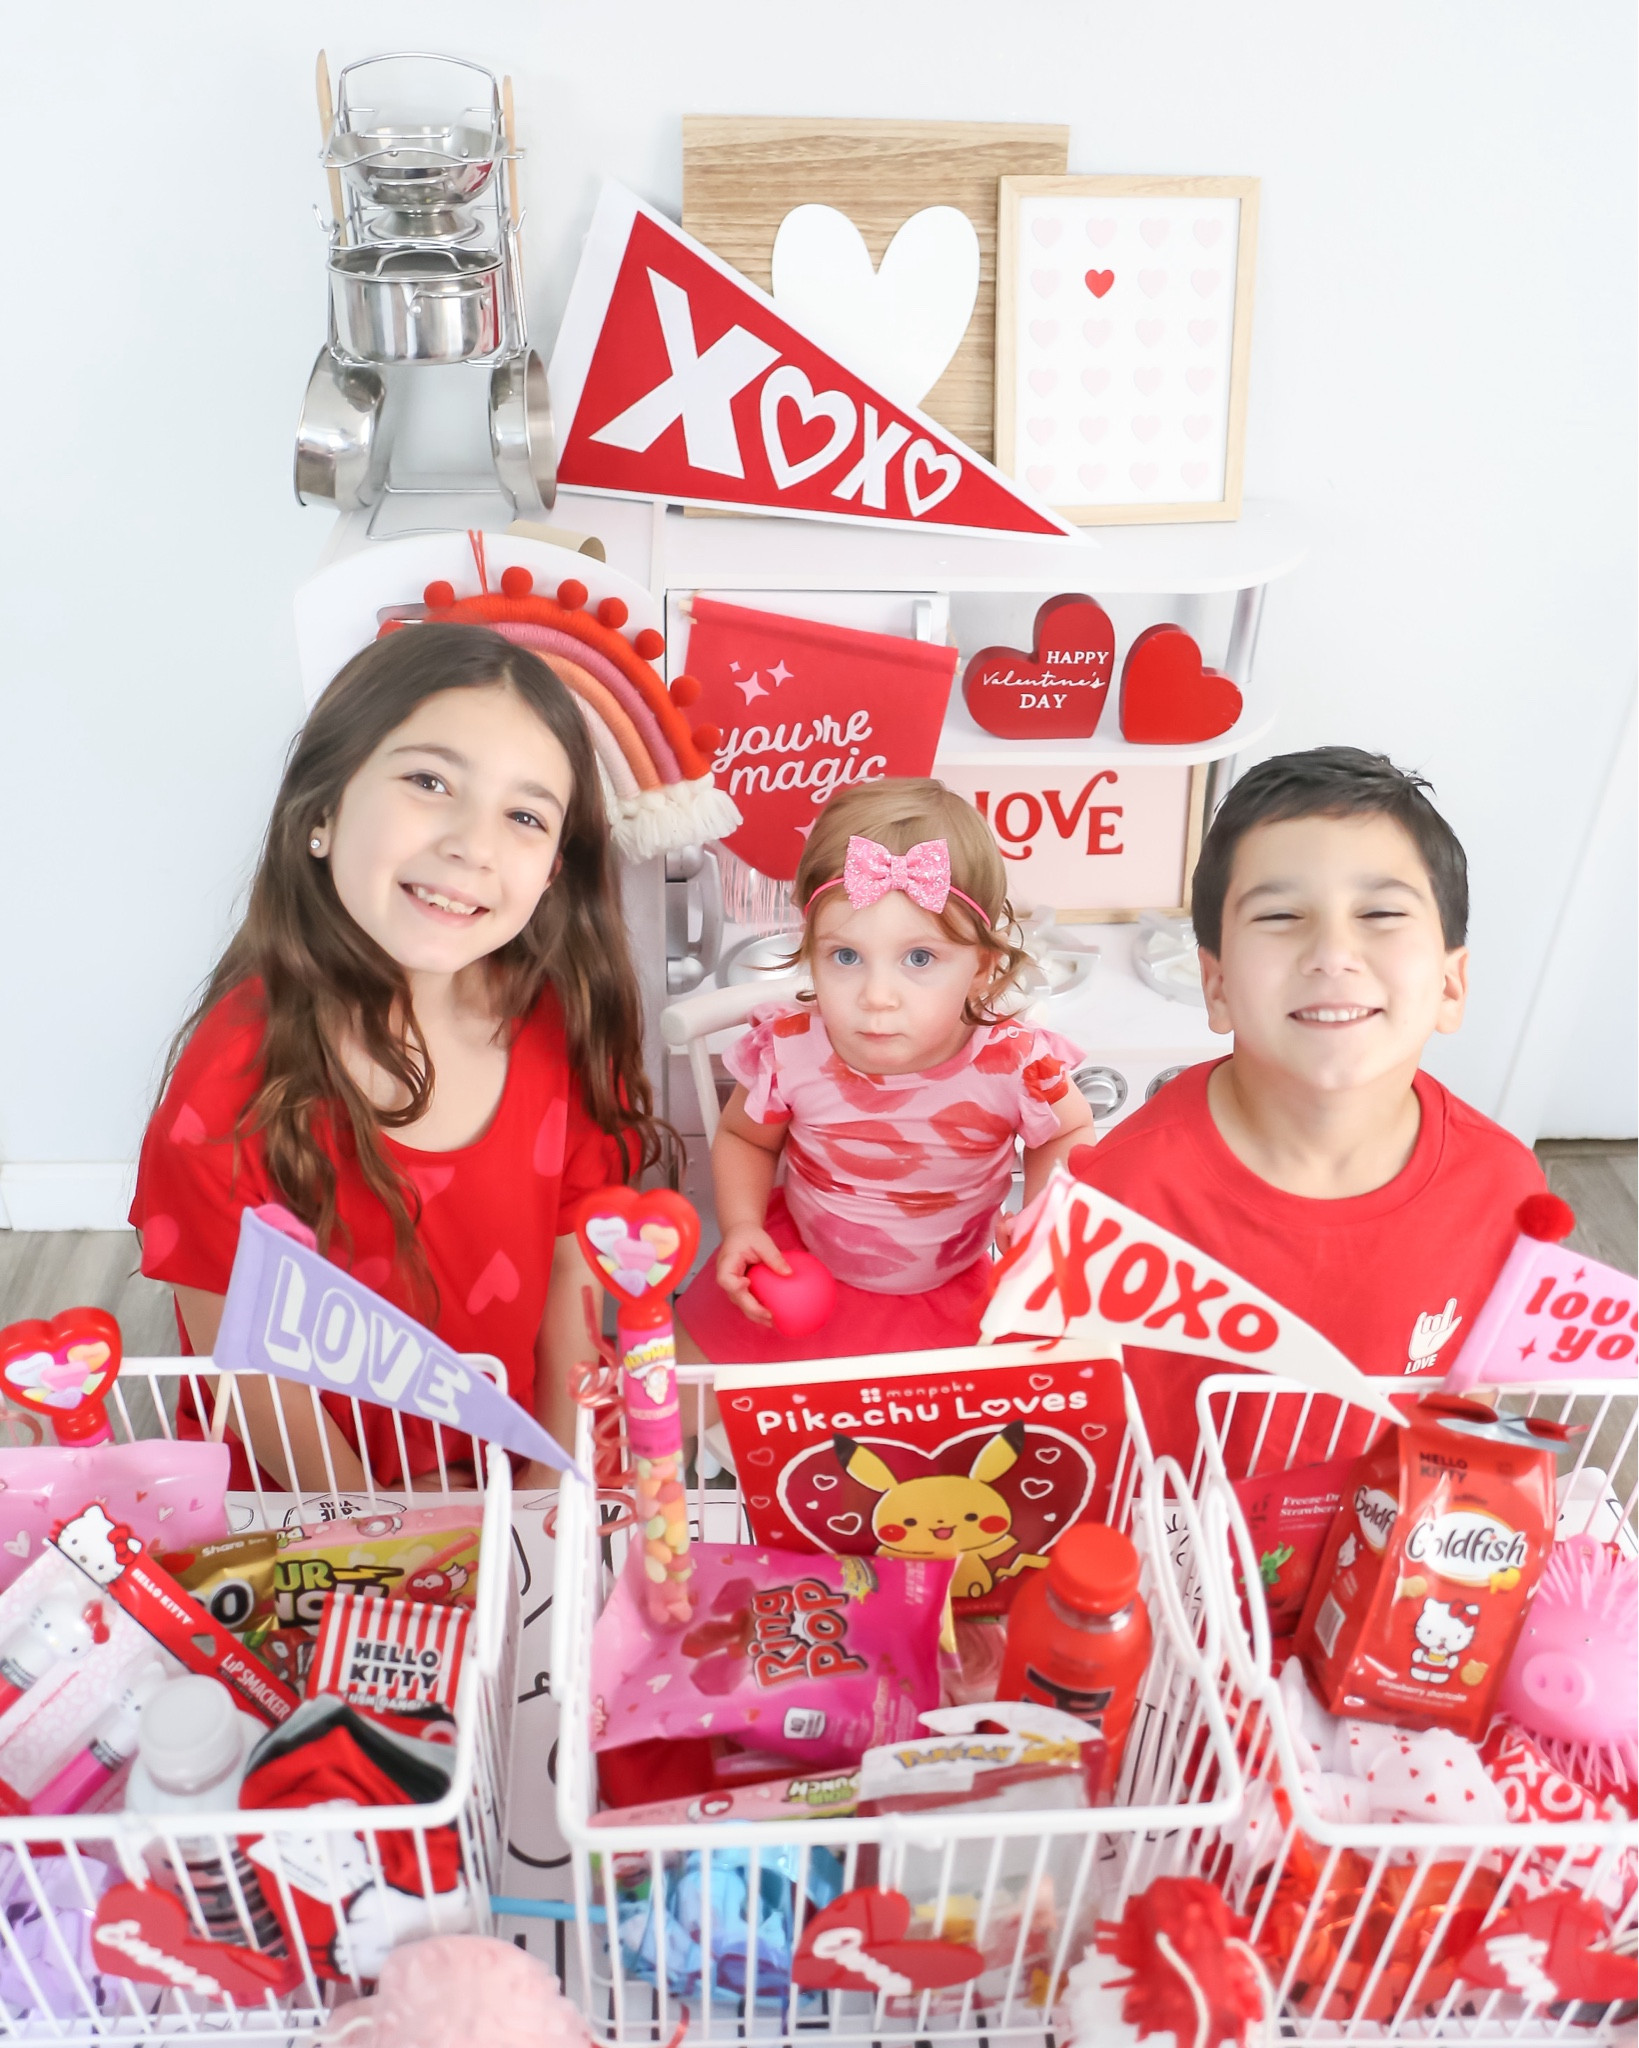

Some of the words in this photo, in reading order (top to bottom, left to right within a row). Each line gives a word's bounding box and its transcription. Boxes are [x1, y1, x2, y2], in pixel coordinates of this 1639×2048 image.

[983, 670, 1106, 689] Valentine's
[1046, 650, 1110, 665] HAPPY
[1019, 693, 1068, 709] DAY
[711, 709, 873, 773] you're
[729, 747, 887, 804] magic
[1024, 1198, 1280, 1354] XOXO
[1524, 1276, 1639, 1334] lov
[264, 1255, 472, 1425] LOVE
[1548, 1325, 1639, 1364] yo
[1404, 1353, 1438, 1376] LOVE
[756, 1401, 940, 1436] Pikachu
[955, 1390, 1088, 1420] Loves
[1419, 1452, 1468, 1469] HELLO
[130, 1568, 163, 1598] HELLO
[159, 1595, 195, 1625] KITTY
[354, 1641, 438, 1668] HELLO
[749, 1586, 811, 1689] Ring
[237, 1669, 292, 1721] SMACKER
[350, 1663, 438, 1689] KITTY
